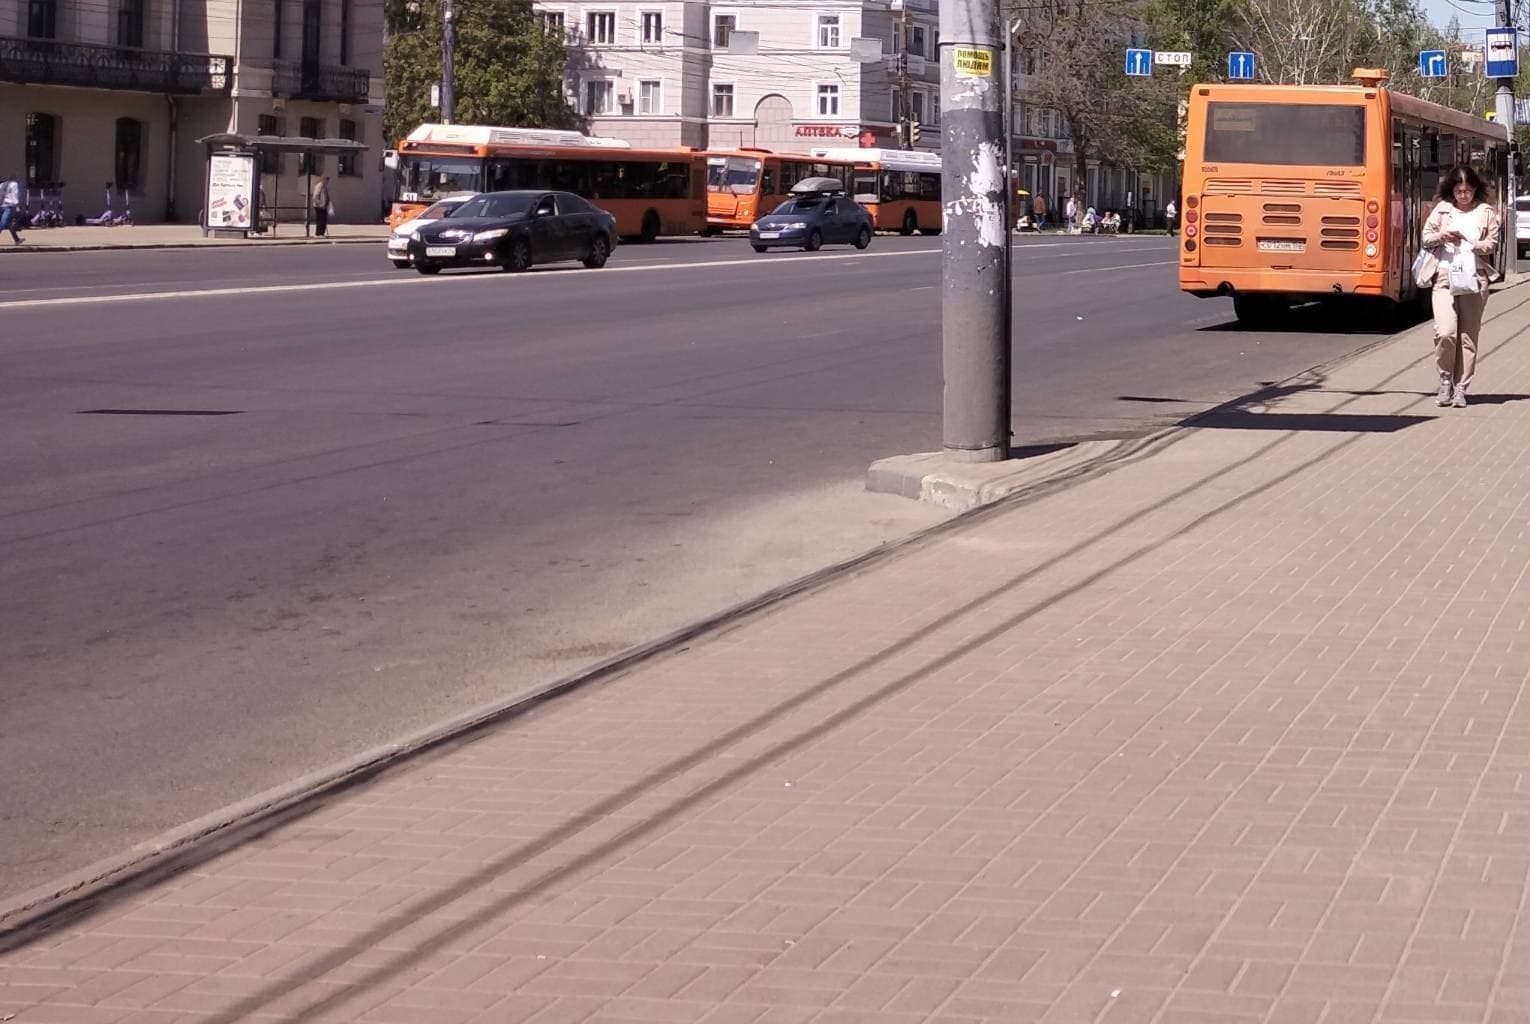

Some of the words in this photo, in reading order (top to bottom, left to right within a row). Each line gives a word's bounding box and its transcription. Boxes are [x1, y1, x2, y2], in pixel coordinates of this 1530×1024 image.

[957, 50, 990, 60] ПОМОЩЬ
[1157, 53, 1189, 63] СТОП
[957, 59, 990, 71] ЛЮДЯМ
[795, 126, 842, 137] АПТЕКА
